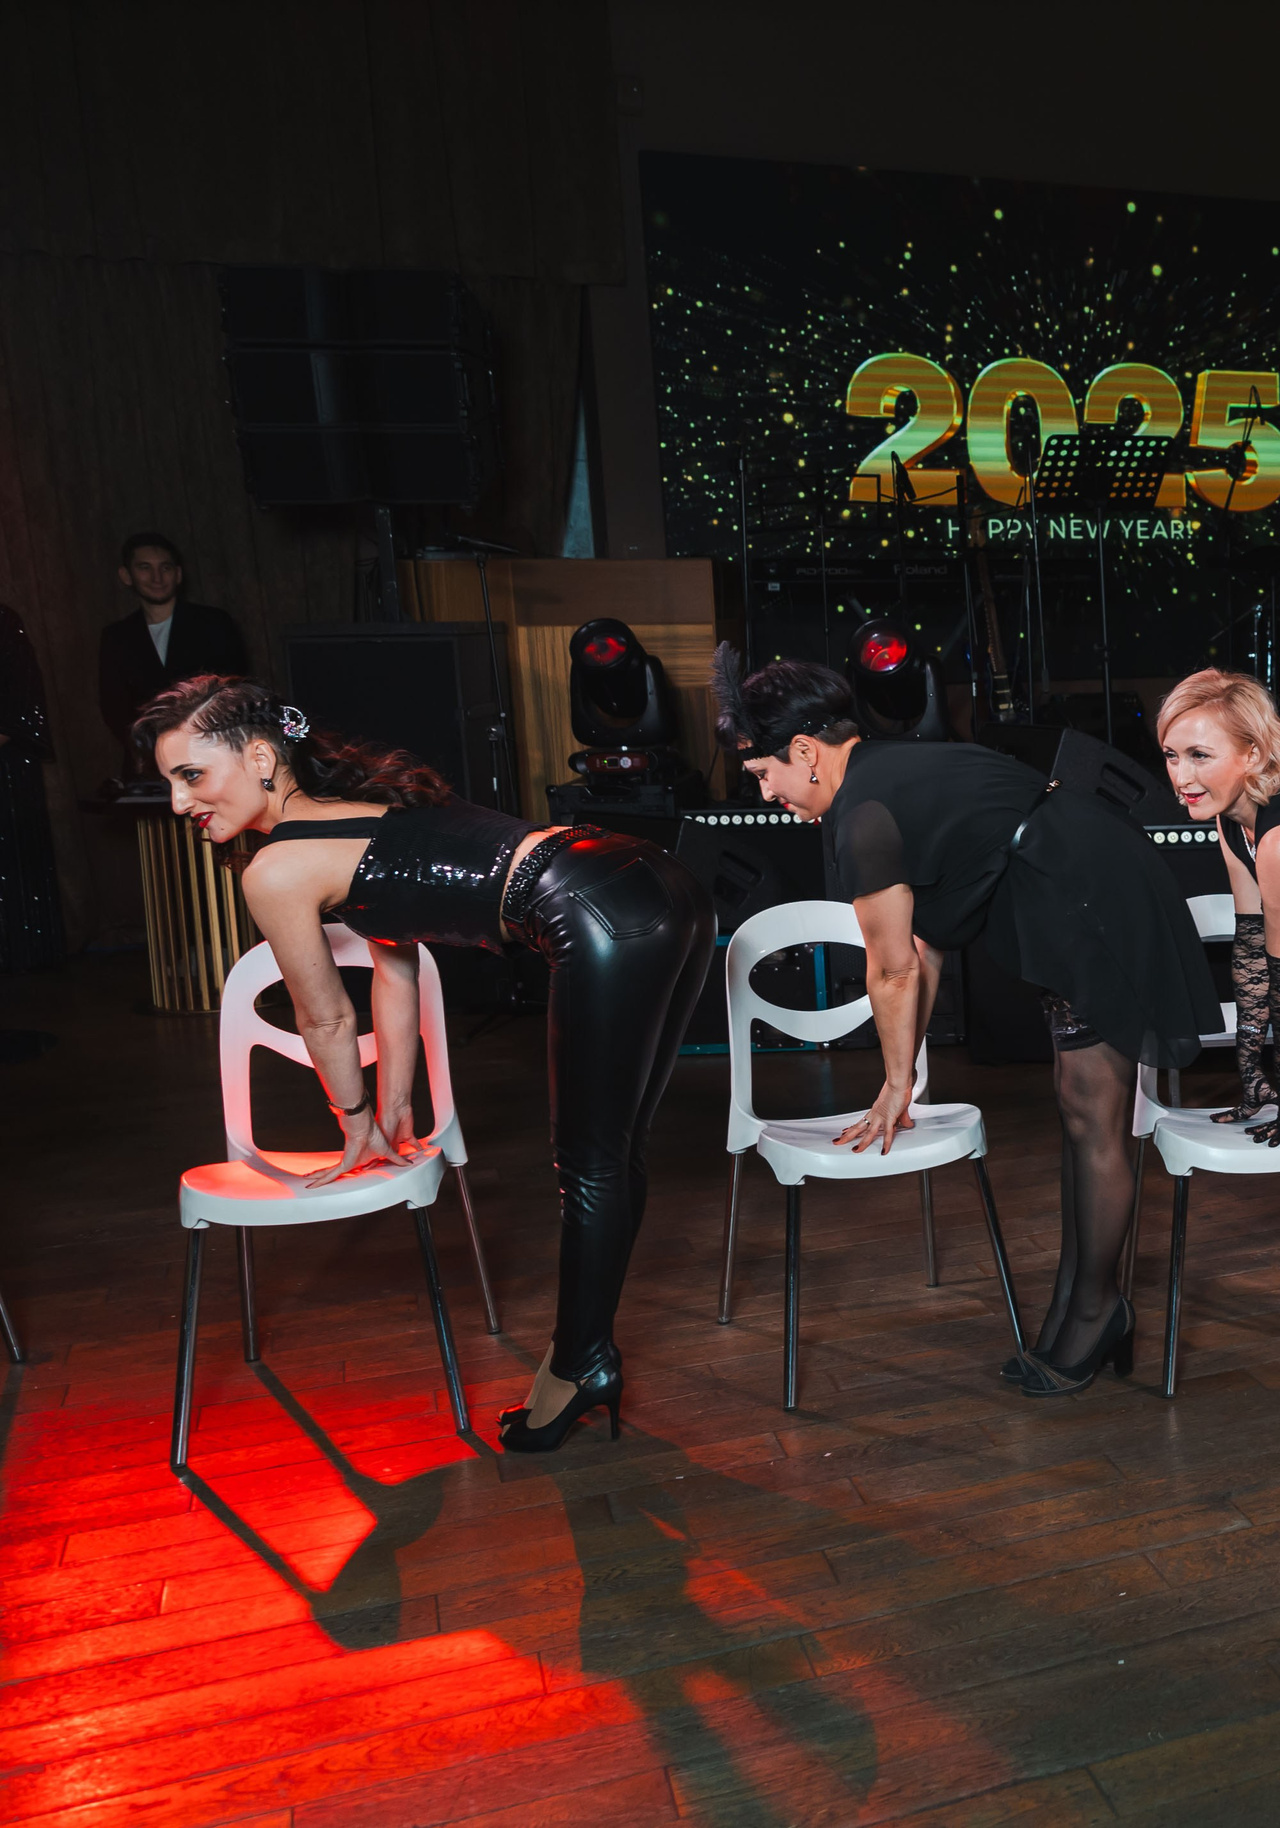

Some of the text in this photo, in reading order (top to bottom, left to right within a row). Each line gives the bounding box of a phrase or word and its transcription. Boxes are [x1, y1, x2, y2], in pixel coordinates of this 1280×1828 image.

[947, 516, 1192, 540] HPPY NEW YEAR!
